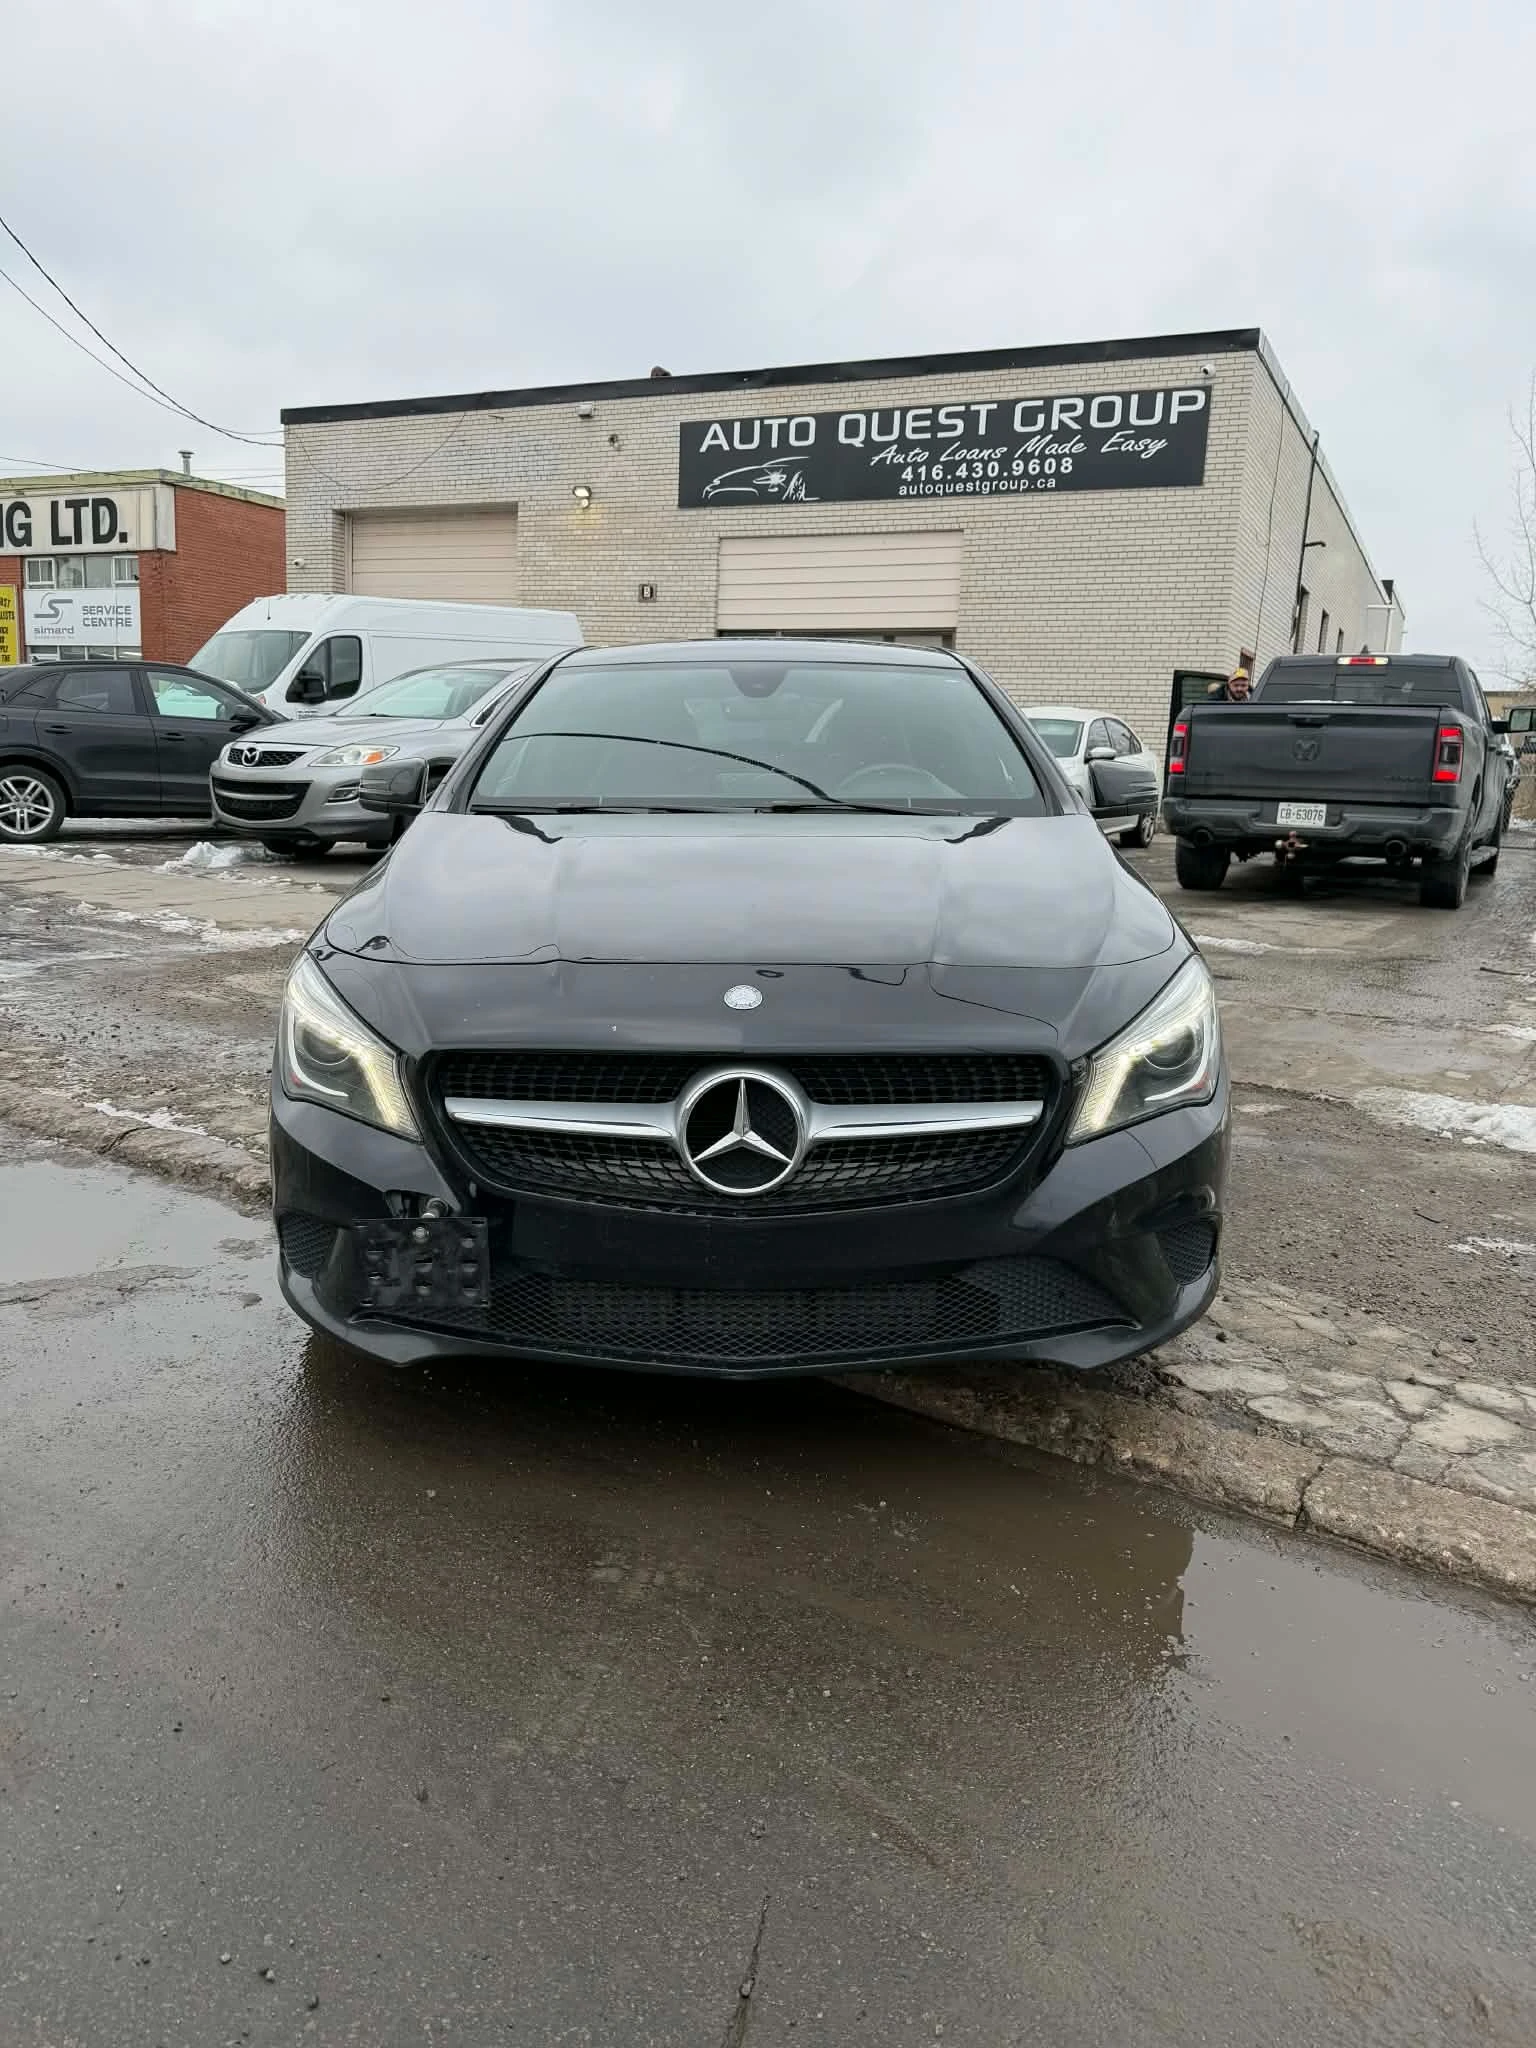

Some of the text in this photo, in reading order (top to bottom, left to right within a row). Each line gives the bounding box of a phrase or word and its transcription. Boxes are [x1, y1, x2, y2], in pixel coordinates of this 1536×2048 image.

[699, 389, 1207, 453] AUTO QUEST GROUP
[870, 430, 1169, 467] Auto Loans Made Easy
[901, 457, 1074, 482] 416.430.9608
[898, 478, 1056, 497] autoquestgroup.ca
[50, 497, 128, 546] LTD.
[82, 605, 132, 615] SERVICE
[33, 625, 75, 634] simard
[82, 617, 133, 627] CENTRE
